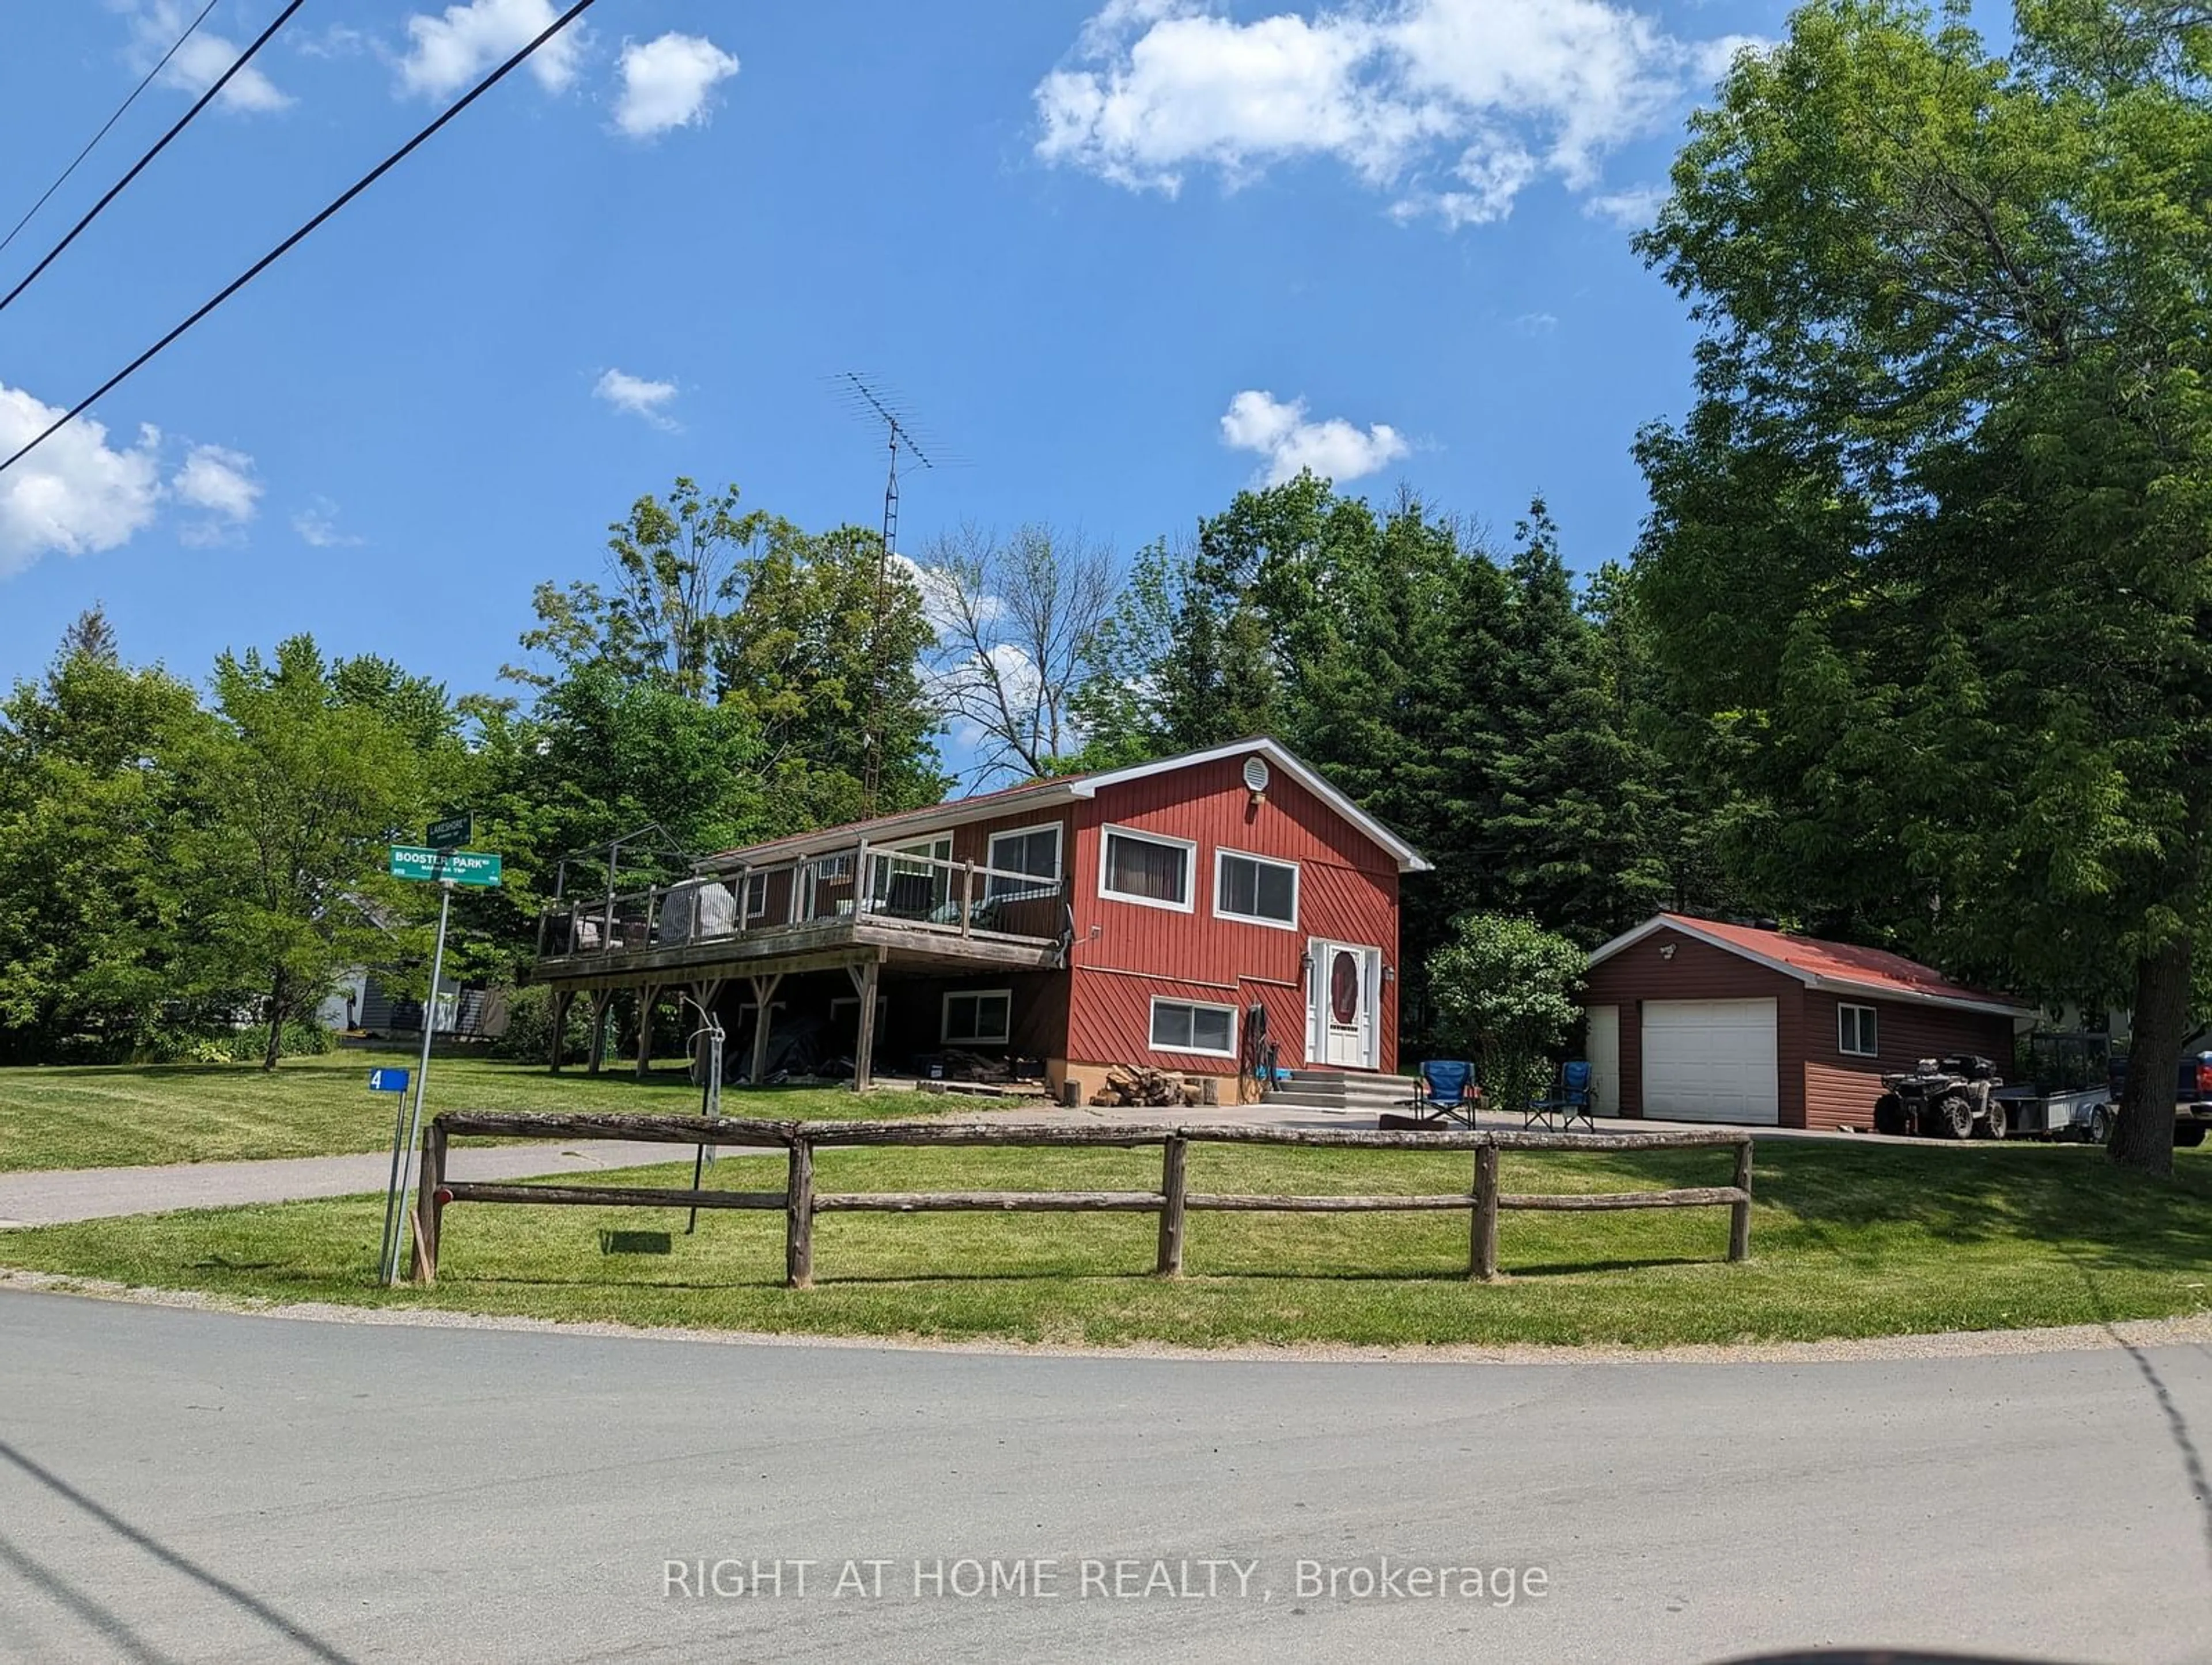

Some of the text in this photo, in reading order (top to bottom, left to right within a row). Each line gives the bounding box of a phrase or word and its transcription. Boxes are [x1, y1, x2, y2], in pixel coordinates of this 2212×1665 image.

[395, 852, 448, 865] BOOSTER
[453, 857, 483, 869] PARK
[371, 1070, 382, 1089] 4
